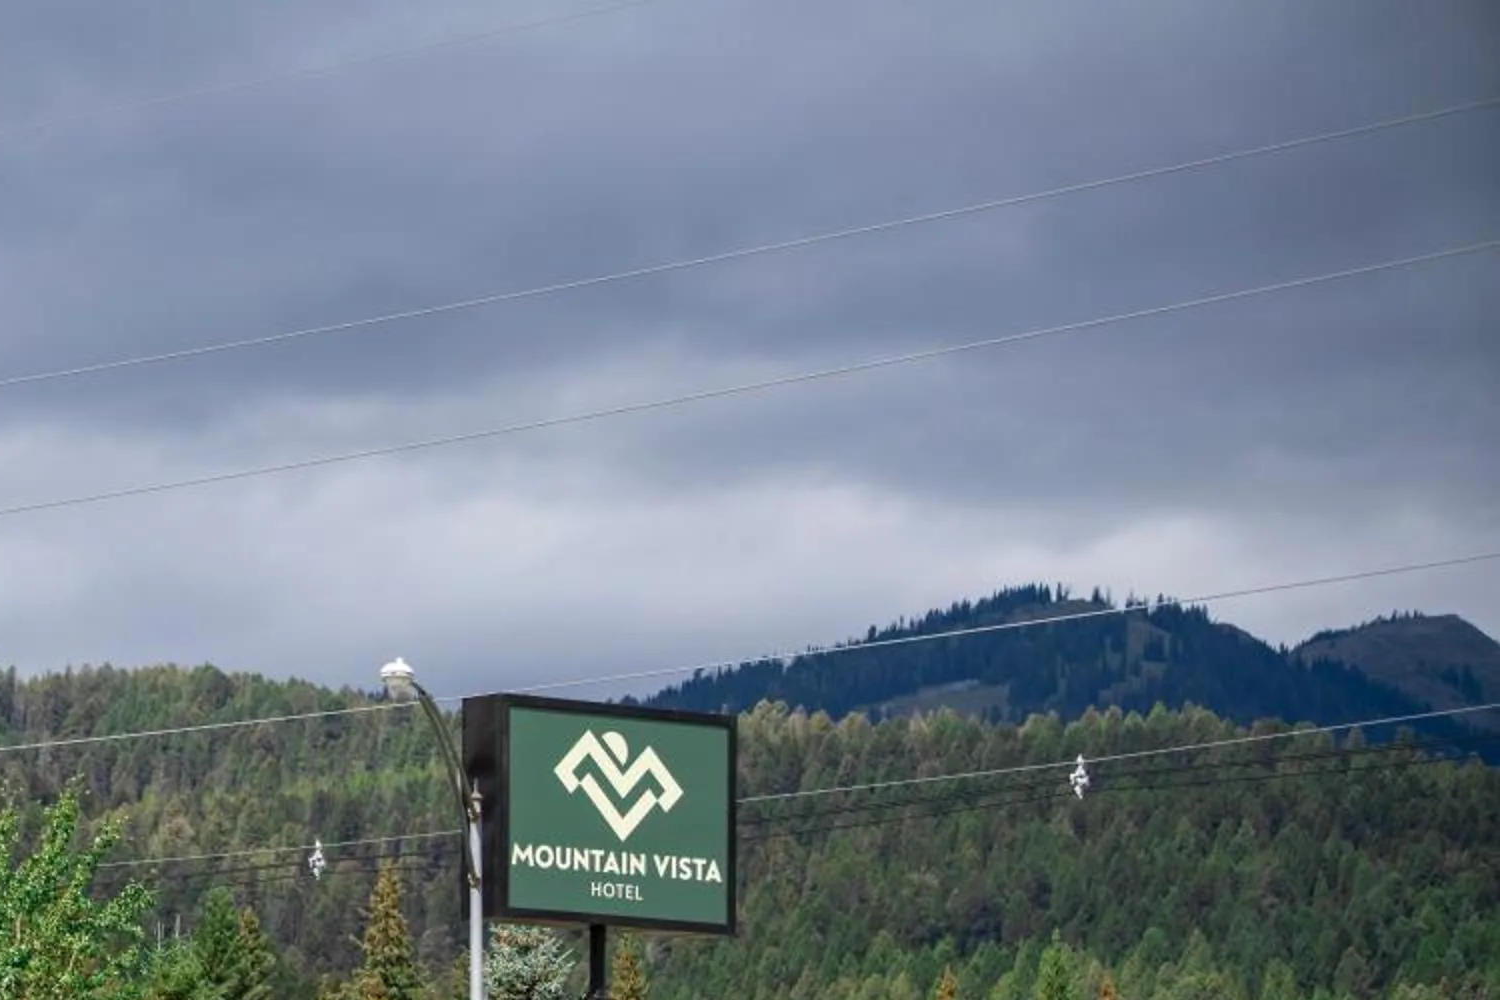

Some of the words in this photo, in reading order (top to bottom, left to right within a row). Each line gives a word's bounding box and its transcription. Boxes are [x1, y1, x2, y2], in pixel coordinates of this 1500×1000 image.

[511, 843, 646, 876] MOUNTAIN
[653, 855, 723, 883] VISTA
[590, 881, 643, 901] HOTEL
